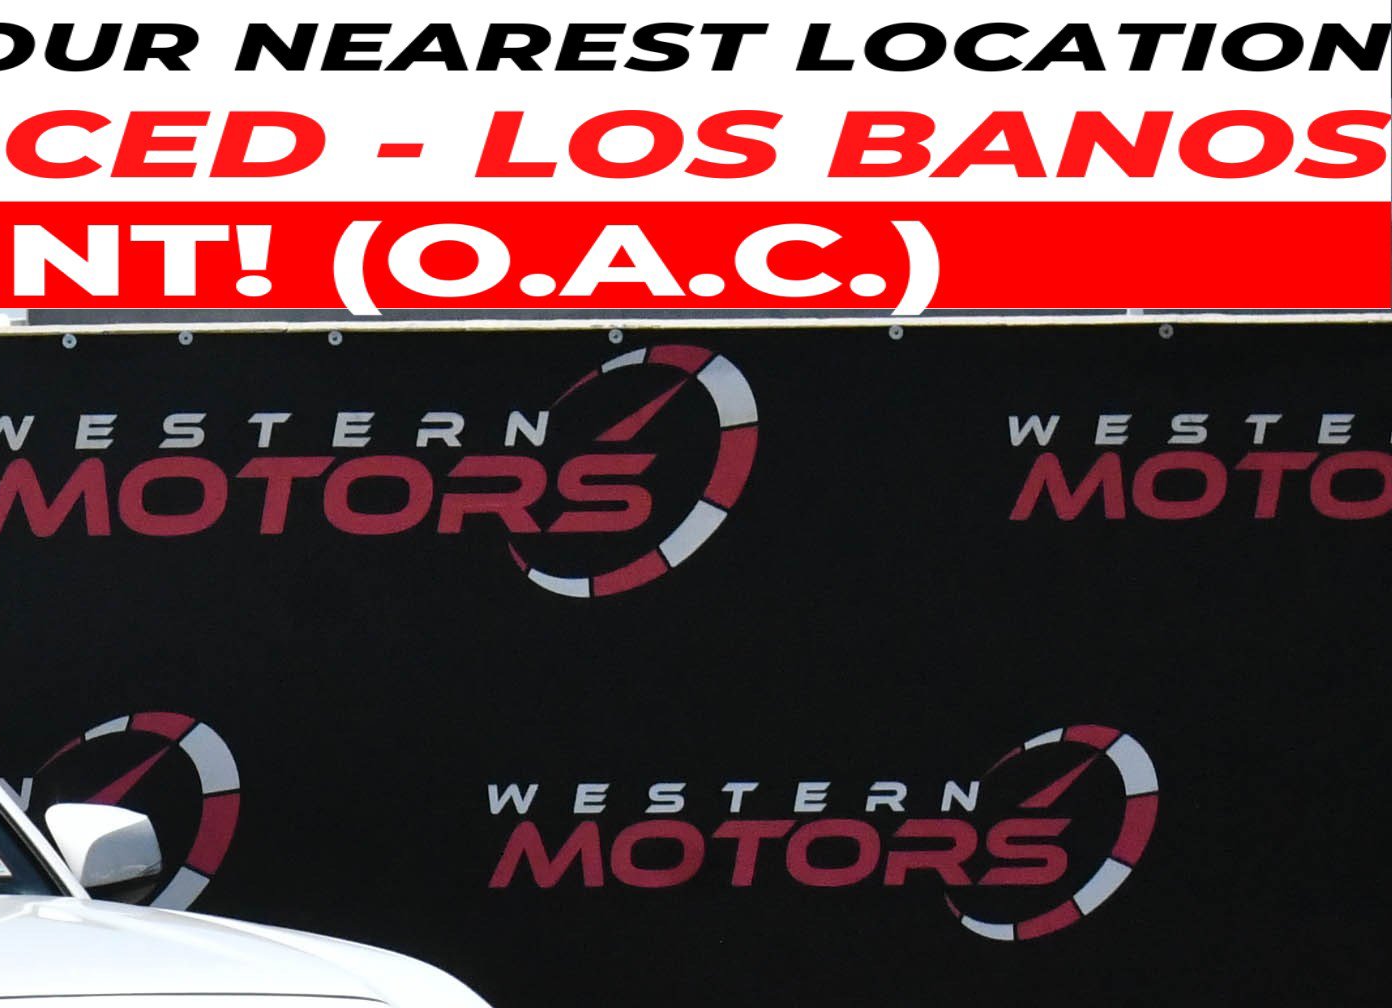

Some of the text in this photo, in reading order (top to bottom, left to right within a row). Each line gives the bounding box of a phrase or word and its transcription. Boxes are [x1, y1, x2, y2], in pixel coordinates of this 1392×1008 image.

[1008, 414, 1392, 446] WESTE
[487, 780, 980, 815] WESTERN
[489, 818, 1071, 888] MOTORS
